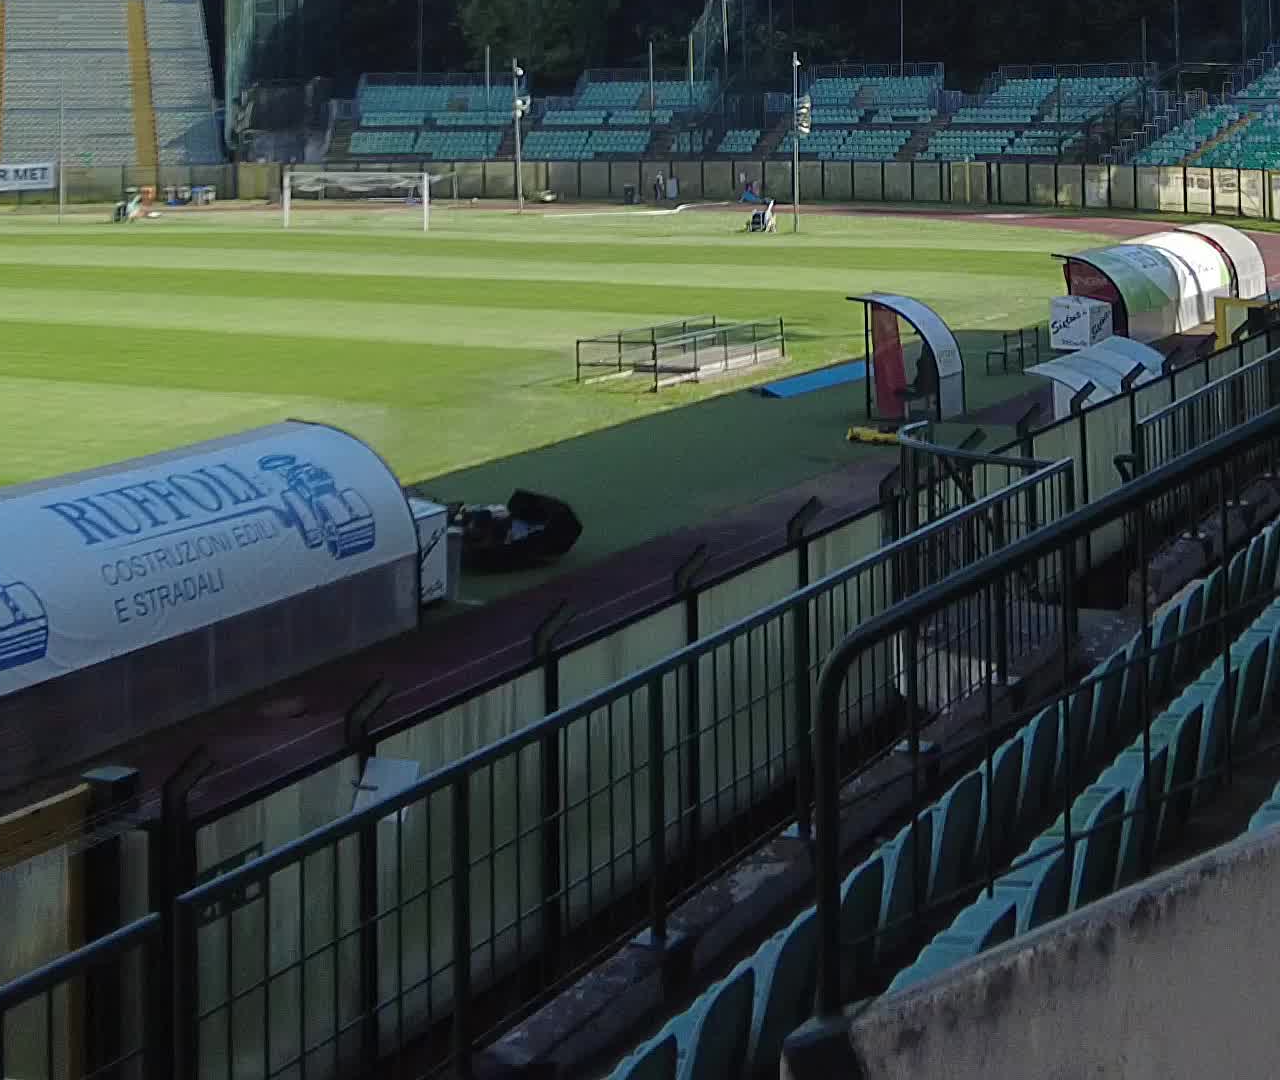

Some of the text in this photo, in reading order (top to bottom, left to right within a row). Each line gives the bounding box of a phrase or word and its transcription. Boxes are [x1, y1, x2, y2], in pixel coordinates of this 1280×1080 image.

[40, 464, 268, 545] RUFFOLI
[101, 529, 232, 587] COSTRUZIONI
[114, 568, 225, 624] E STRADALI
